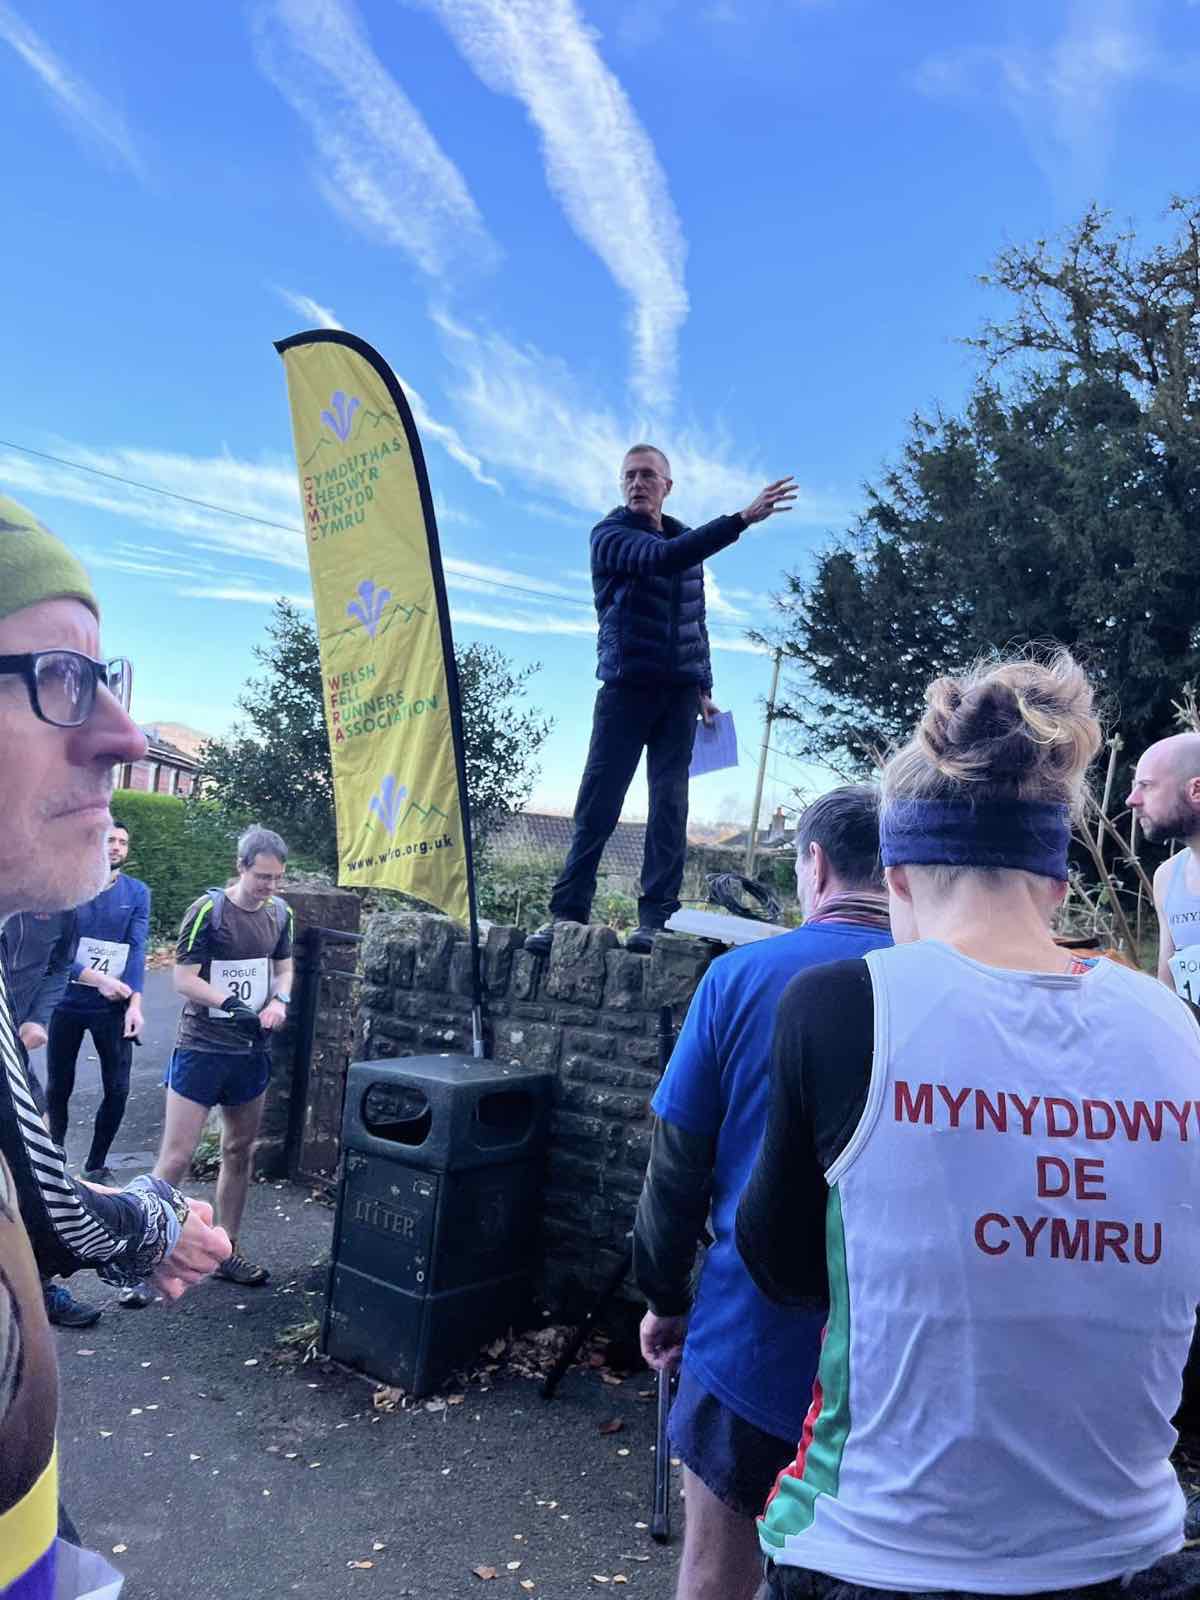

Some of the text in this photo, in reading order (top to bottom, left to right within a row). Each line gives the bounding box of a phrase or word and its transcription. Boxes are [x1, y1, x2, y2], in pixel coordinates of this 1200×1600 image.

[308, 486, 374, 523] MYNYDD
[310, 508, 366, 540] CYMRU
[328, 664, 376, 690] WELSH
[331, 688, 359, 709] FELL
[333, 690, 404, 725] RUNNERS
[335, 695, 438, 743] ASSOCIATION
[87, 945, 118, 957] ROGUE
[89, 957, 111, 975] 74
[222, 968, 257, 978] ROGUE
[1179, 959, 1200, 973] RO
[228, 980, 252, 1001] 30
[1183, 979, 1200, 1002] 1
[1036, 1155, 1107, 1200] DE
[354, 1199, 415, 1238] LITTER
[974, 1212, 1163, 1265] CYMRU
